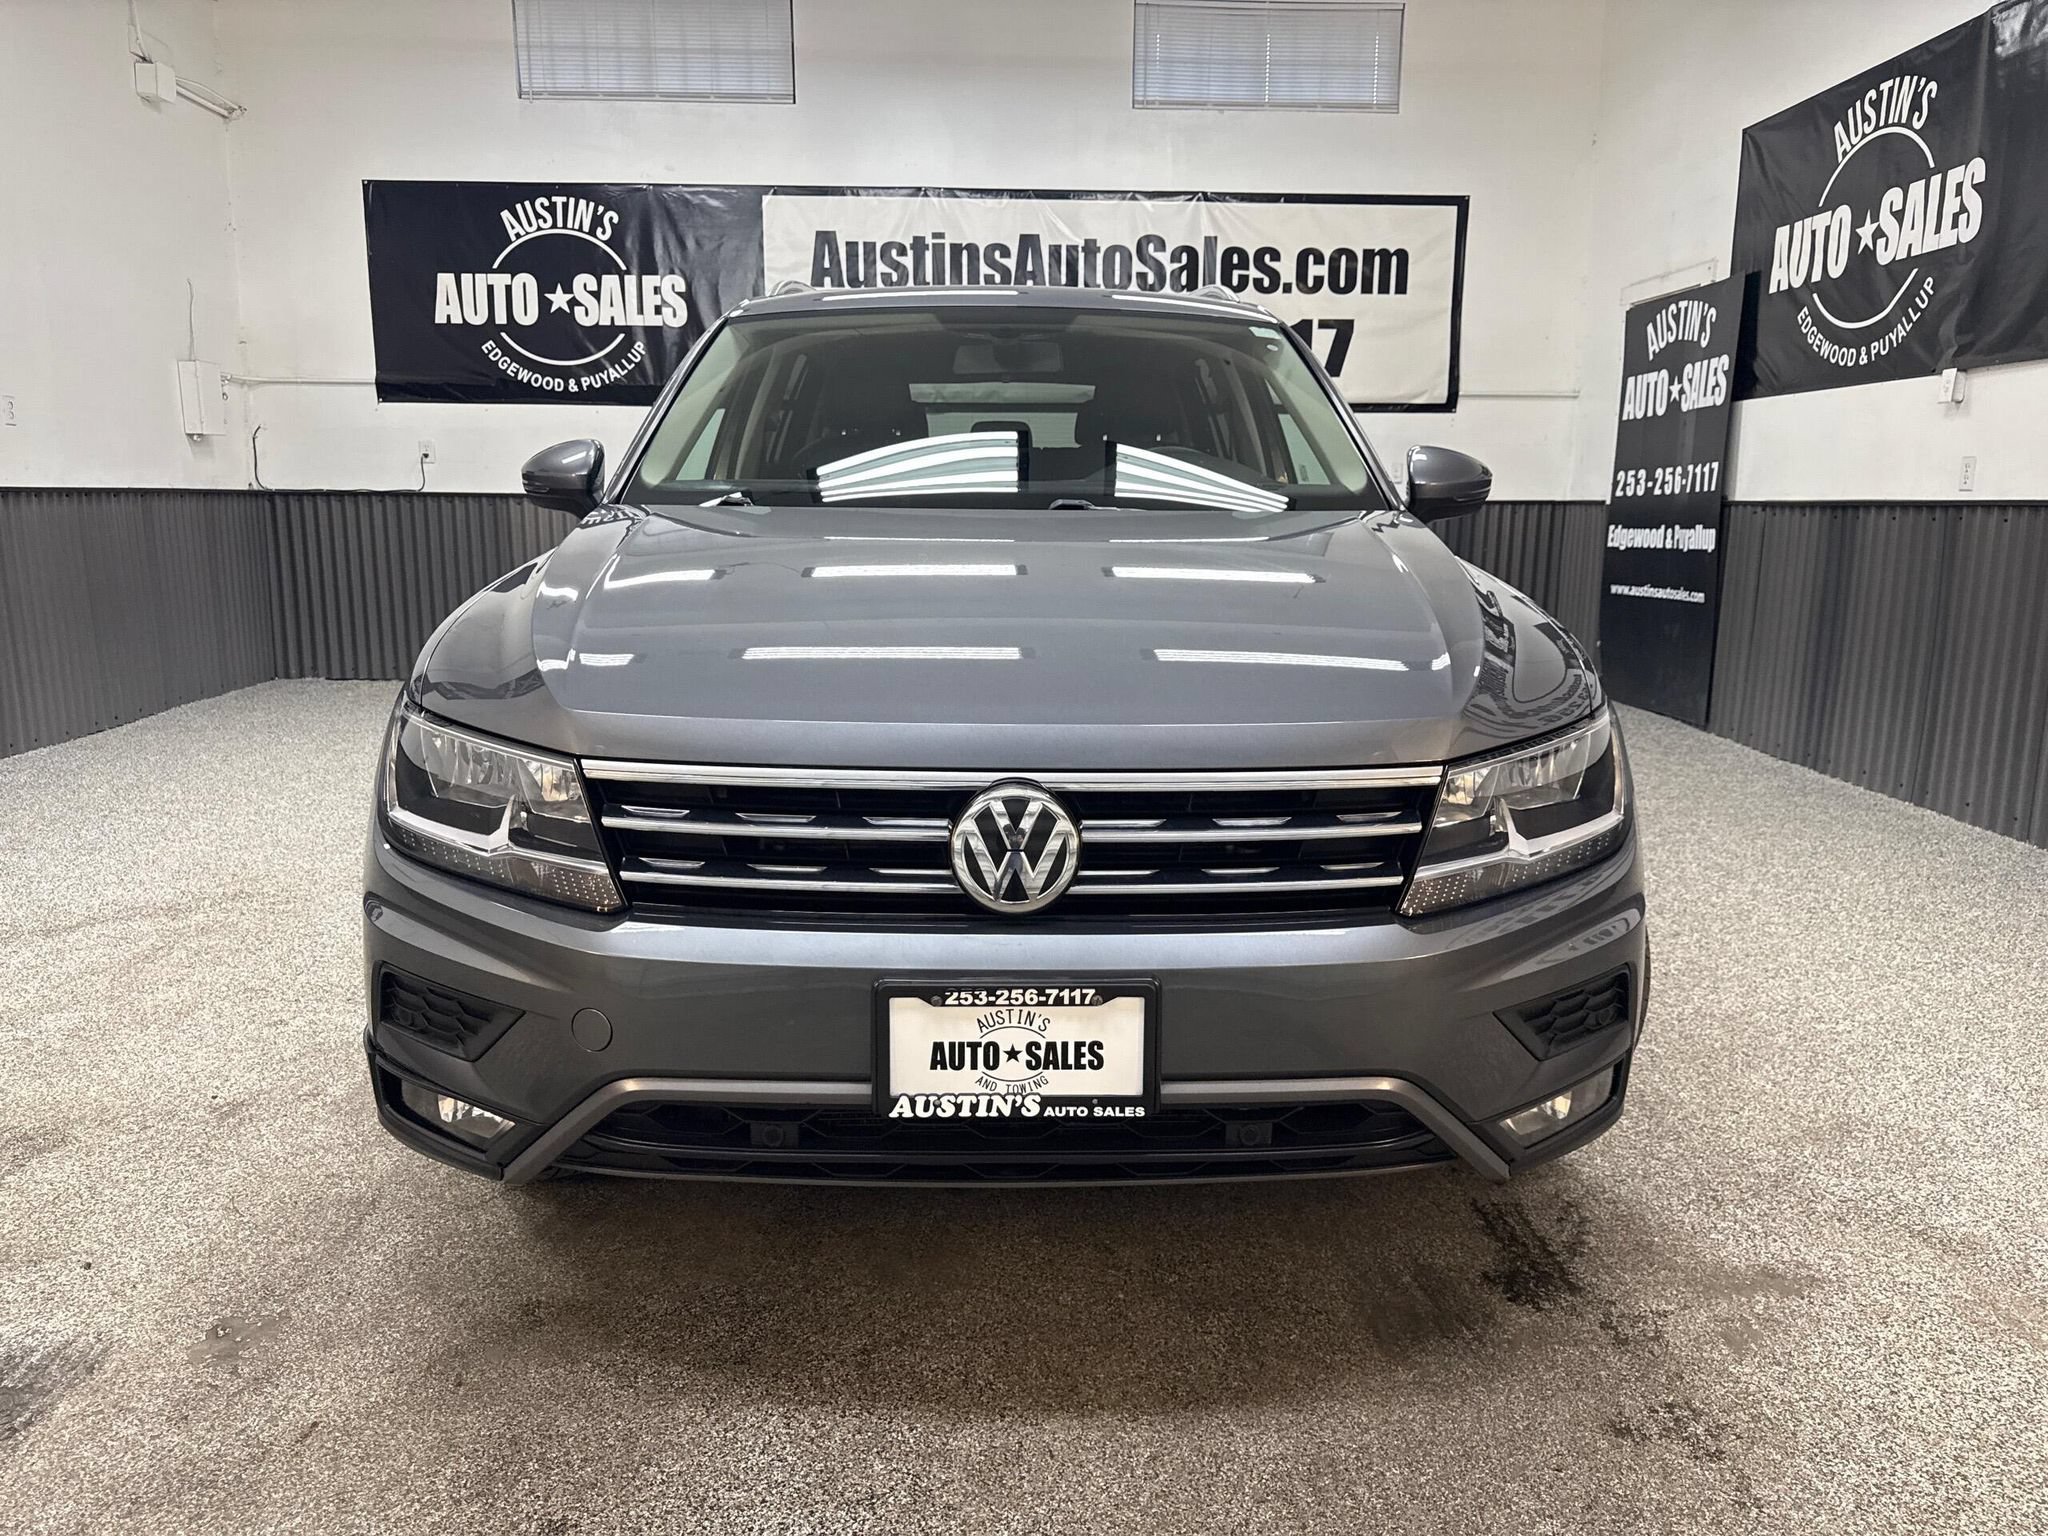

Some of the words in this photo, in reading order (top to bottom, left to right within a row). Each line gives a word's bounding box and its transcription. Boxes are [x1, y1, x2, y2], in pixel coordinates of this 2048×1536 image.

[1833, 75, 1938, 163] AUSTIN'S
[500, 196, 619, 243] AUSTIN'S
[1768, 204, 1852, 295] AUTO
[1875, 156, 1987, 266] SALES
[810, 231, 1410, 296] AustinsAutoSales.com
[434, 272, 539, 325] AUTO
[573, 274, 689, 328] SALES
[1797, 305, 1857, 367] EDGEWOOD
[1859, 347, 1868, 366] &
[1870, 276, 1935, 360] PUYALLUP
[1646, 300, 1717, 361] AUSTIN'S
[481, 340, 564, 393] EDGEWOOD
[568, 380, 579, 393] &
[580, 341, 648, 392] PUYALLUP
[1622, 371, 1670, 421] AUTO
[1681, 354, 1730, 412] SALES
[1615, 461, 1719, 498] 253-256-7117
[1607, 524, 1665, 550] Edgewood
[1665, 528, 1673, 549] &
[945, 988, 1095, 1006] 253-256-7117
[976, 1009, 1051, 1033] AUSTIN'S
[929, 1041, 1000, 1070] AUTO
[1025, 1041, 1105, 1070] SALES
[888, 1094, 1041, 1118] AUSTIN'S
[1043, 1106, 1089, 1118] AUTO
[1093, 1106, 1146, 1118] SALES
[974, 1076, 997, 1092] AND
[1005, 1075, 1049, 1096] TOWING
